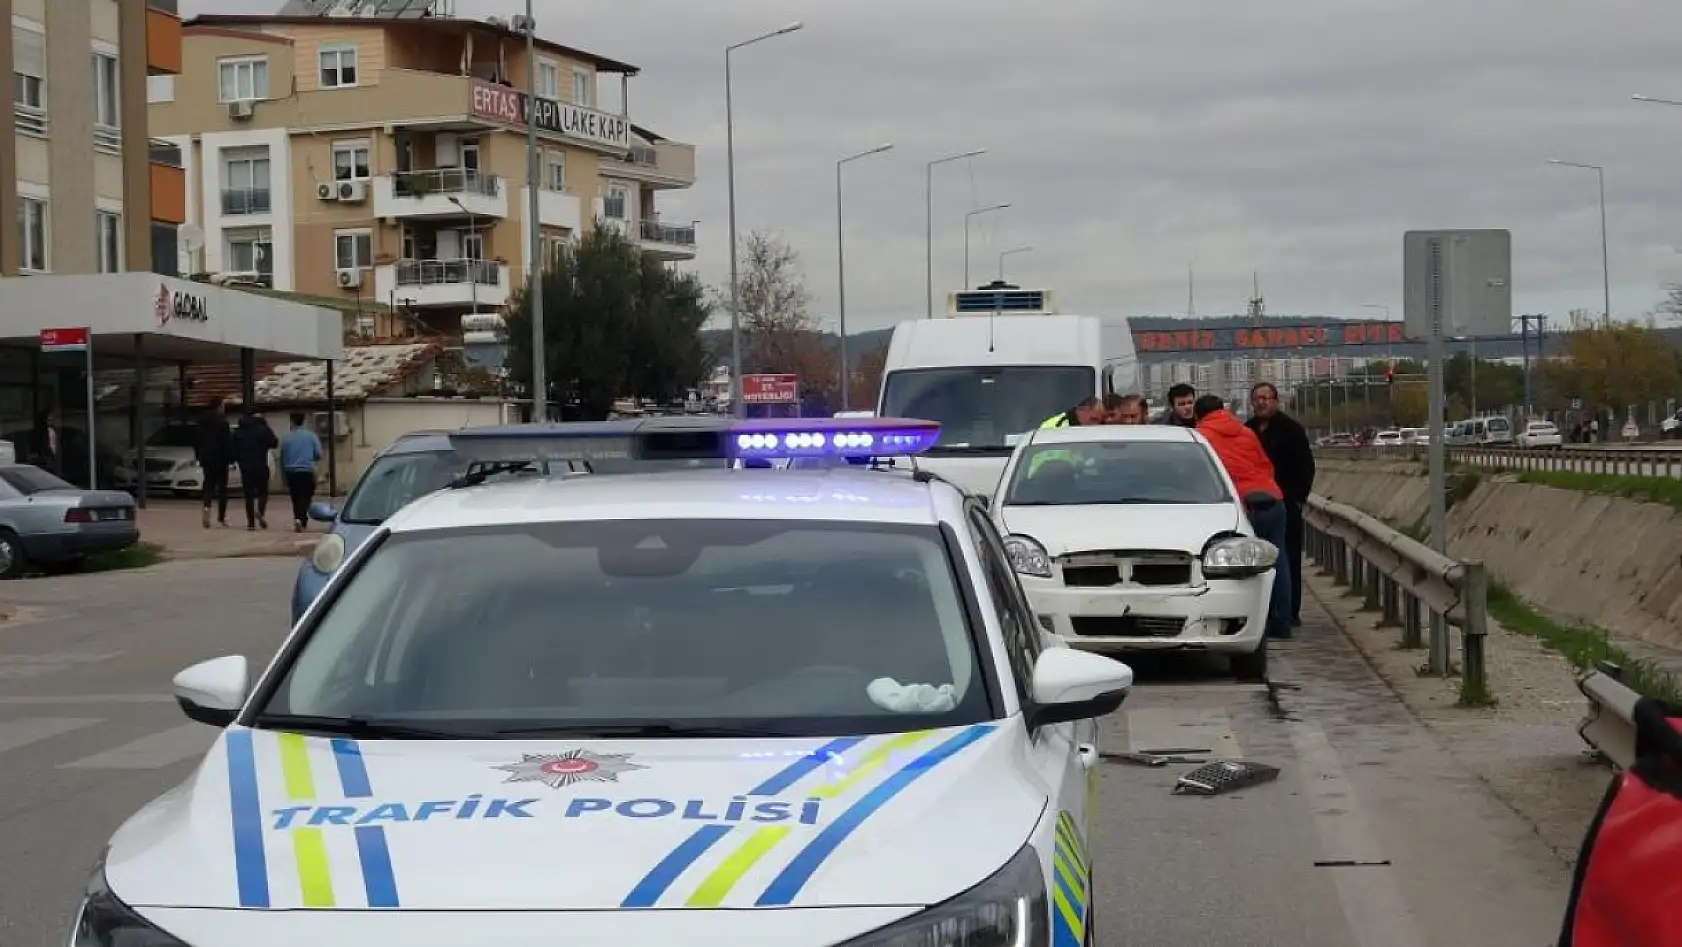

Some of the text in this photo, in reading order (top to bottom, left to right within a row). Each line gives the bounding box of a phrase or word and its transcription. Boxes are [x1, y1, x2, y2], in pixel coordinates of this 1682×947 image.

[473, 86, 629, 146] ERTAŞ API LAKE KAPI
[173, 289, 208, 322] GLOBAL
[271, 793, 823, 831] TRAFİK POLİSİ
